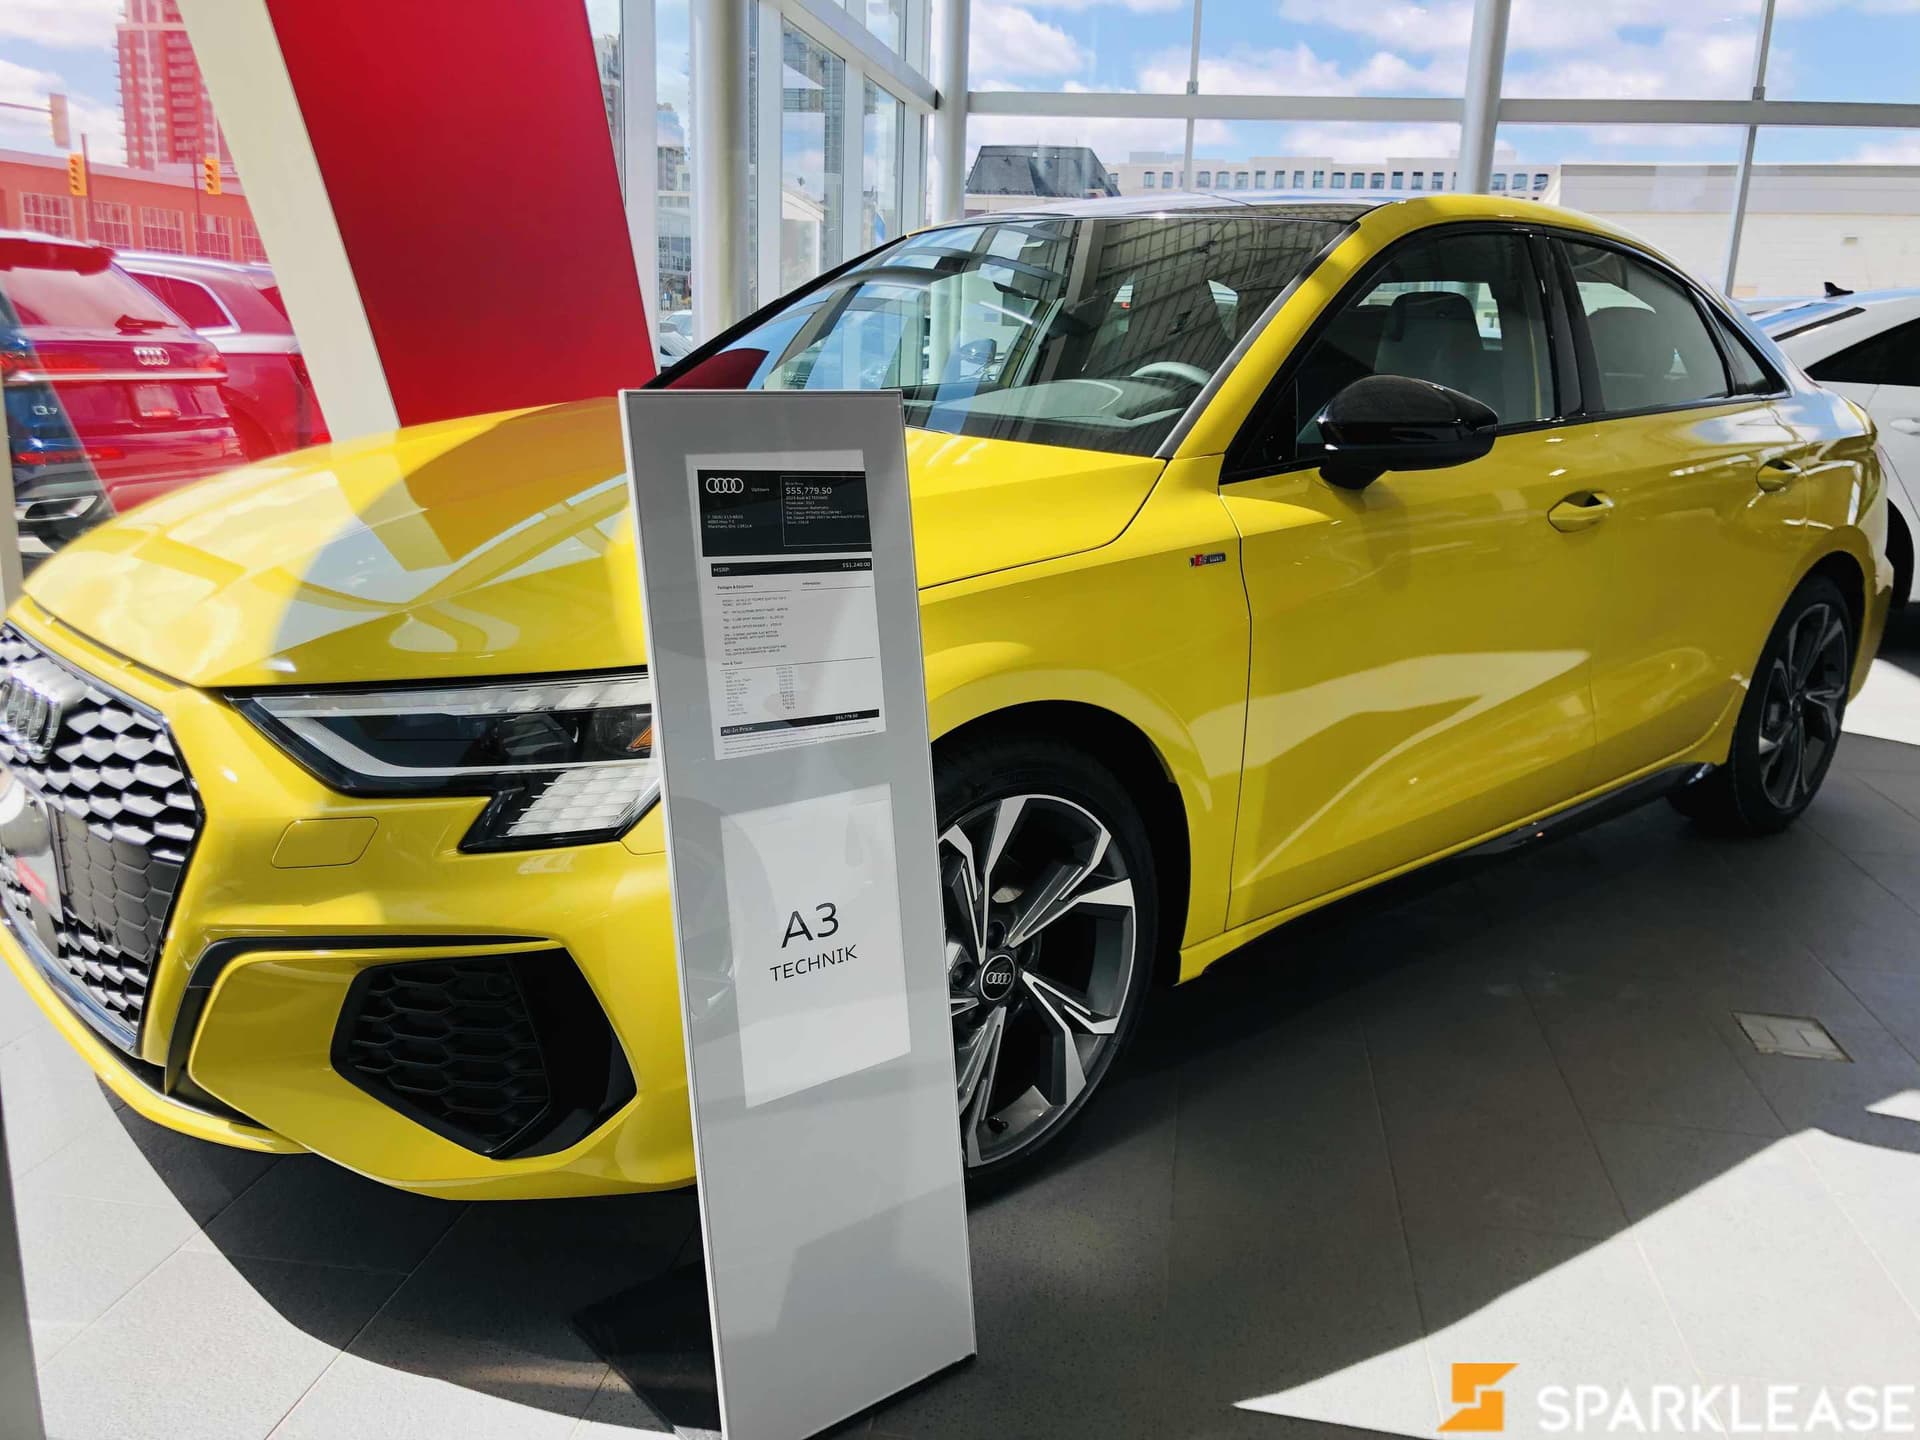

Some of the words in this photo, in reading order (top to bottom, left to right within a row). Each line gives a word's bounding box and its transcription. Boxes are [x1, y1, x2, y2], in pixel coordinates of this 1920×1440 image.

[785, 487, 833, 495] $55,779.50
[781, 902, 839, 949] A3
[769, 943, 859, 982] TECHNIK
